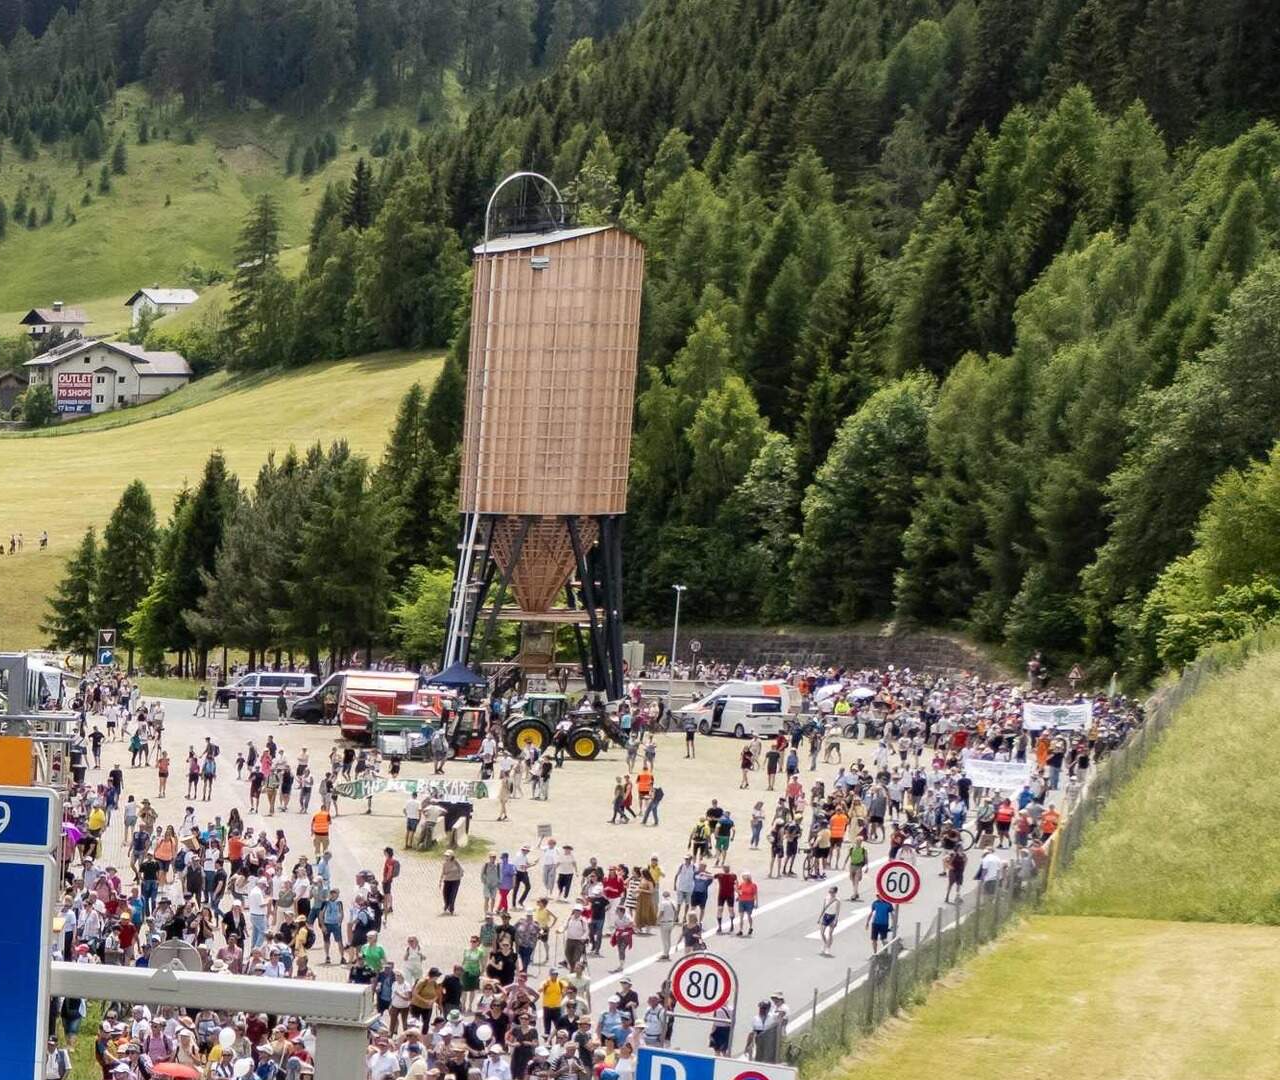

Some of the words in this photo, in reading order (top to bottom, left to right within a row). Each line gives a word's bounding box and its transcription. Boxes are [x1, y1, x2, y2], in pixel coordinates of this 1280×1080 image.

[59, 374, 91, 383] OUTLET
[885, 871, 910, 894] 60
[686, 970, 719, 1001] 80
